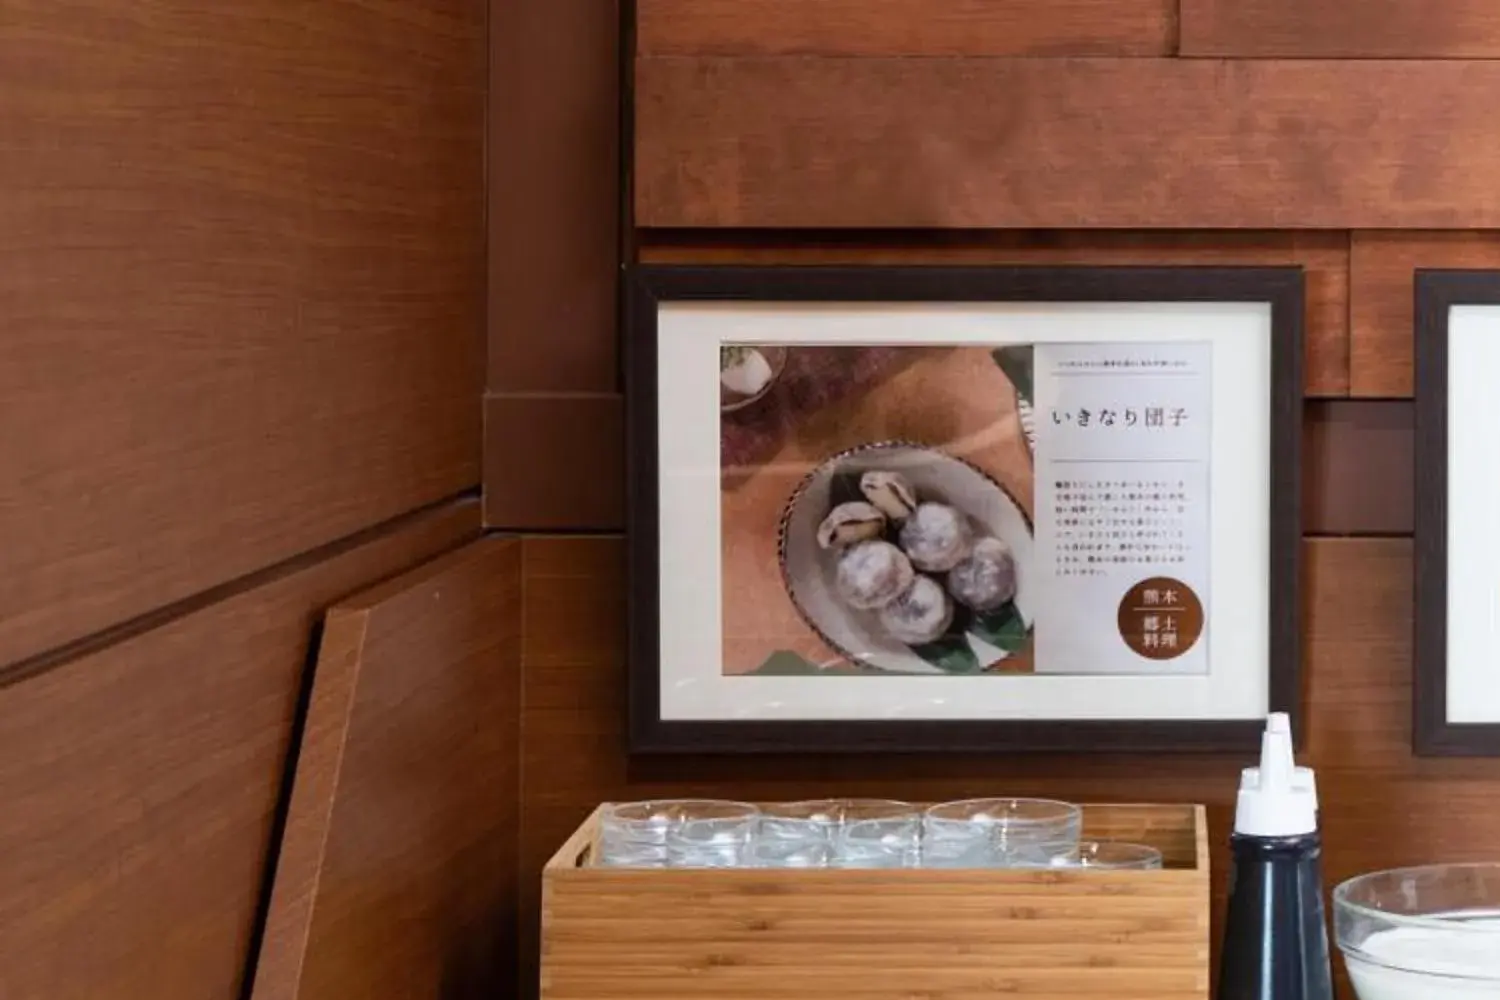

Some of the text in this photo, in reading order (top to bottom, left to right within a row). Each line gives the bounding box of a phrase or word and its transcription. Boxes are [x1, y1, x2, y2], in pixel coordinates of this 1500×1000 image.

[1051, 407, 1189, 428] いきなり団子
